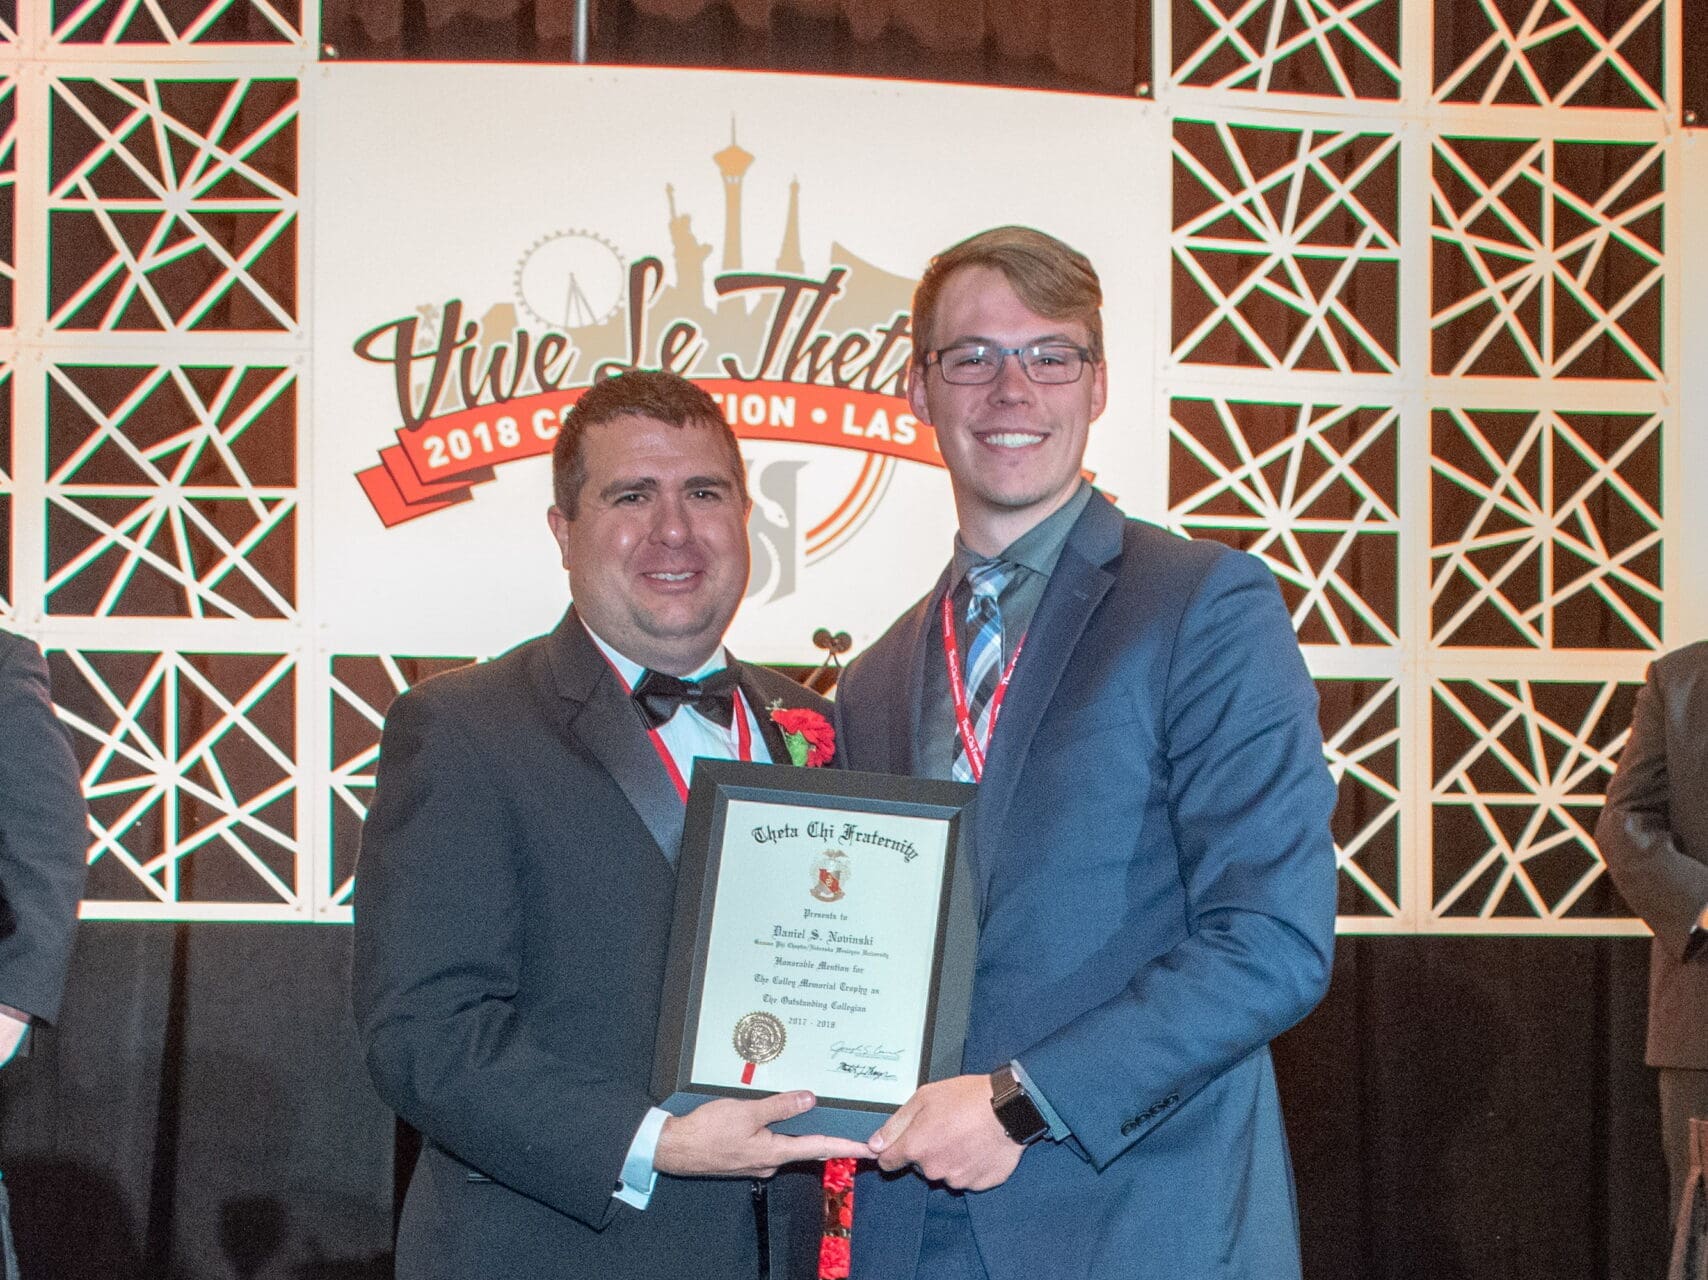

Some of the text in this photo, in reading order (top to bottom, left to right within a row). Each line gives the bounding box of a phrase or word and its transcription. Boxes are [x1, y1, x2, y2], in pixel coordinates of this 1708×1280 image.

[594, 256, 703, 385] Le
[422, 416, 521, 469] 2018
[841, 403, 918, 445] LAS
[751, 821, 919, 863] Theta Chi Fraternity
[773, 925, 806, 940] Daniel
[809, 929, 823, 941] S.
[774, 956, 865, 973] Honorable Mention for
[754, 973, 769, 985] The
[798, 978, 836, 990] Memorial
[839, 982, 868, 996] Trophy
[762, 993, 867, 1013] The Outstanding Collegian
[788, 1017, 807, 1026] 2017
